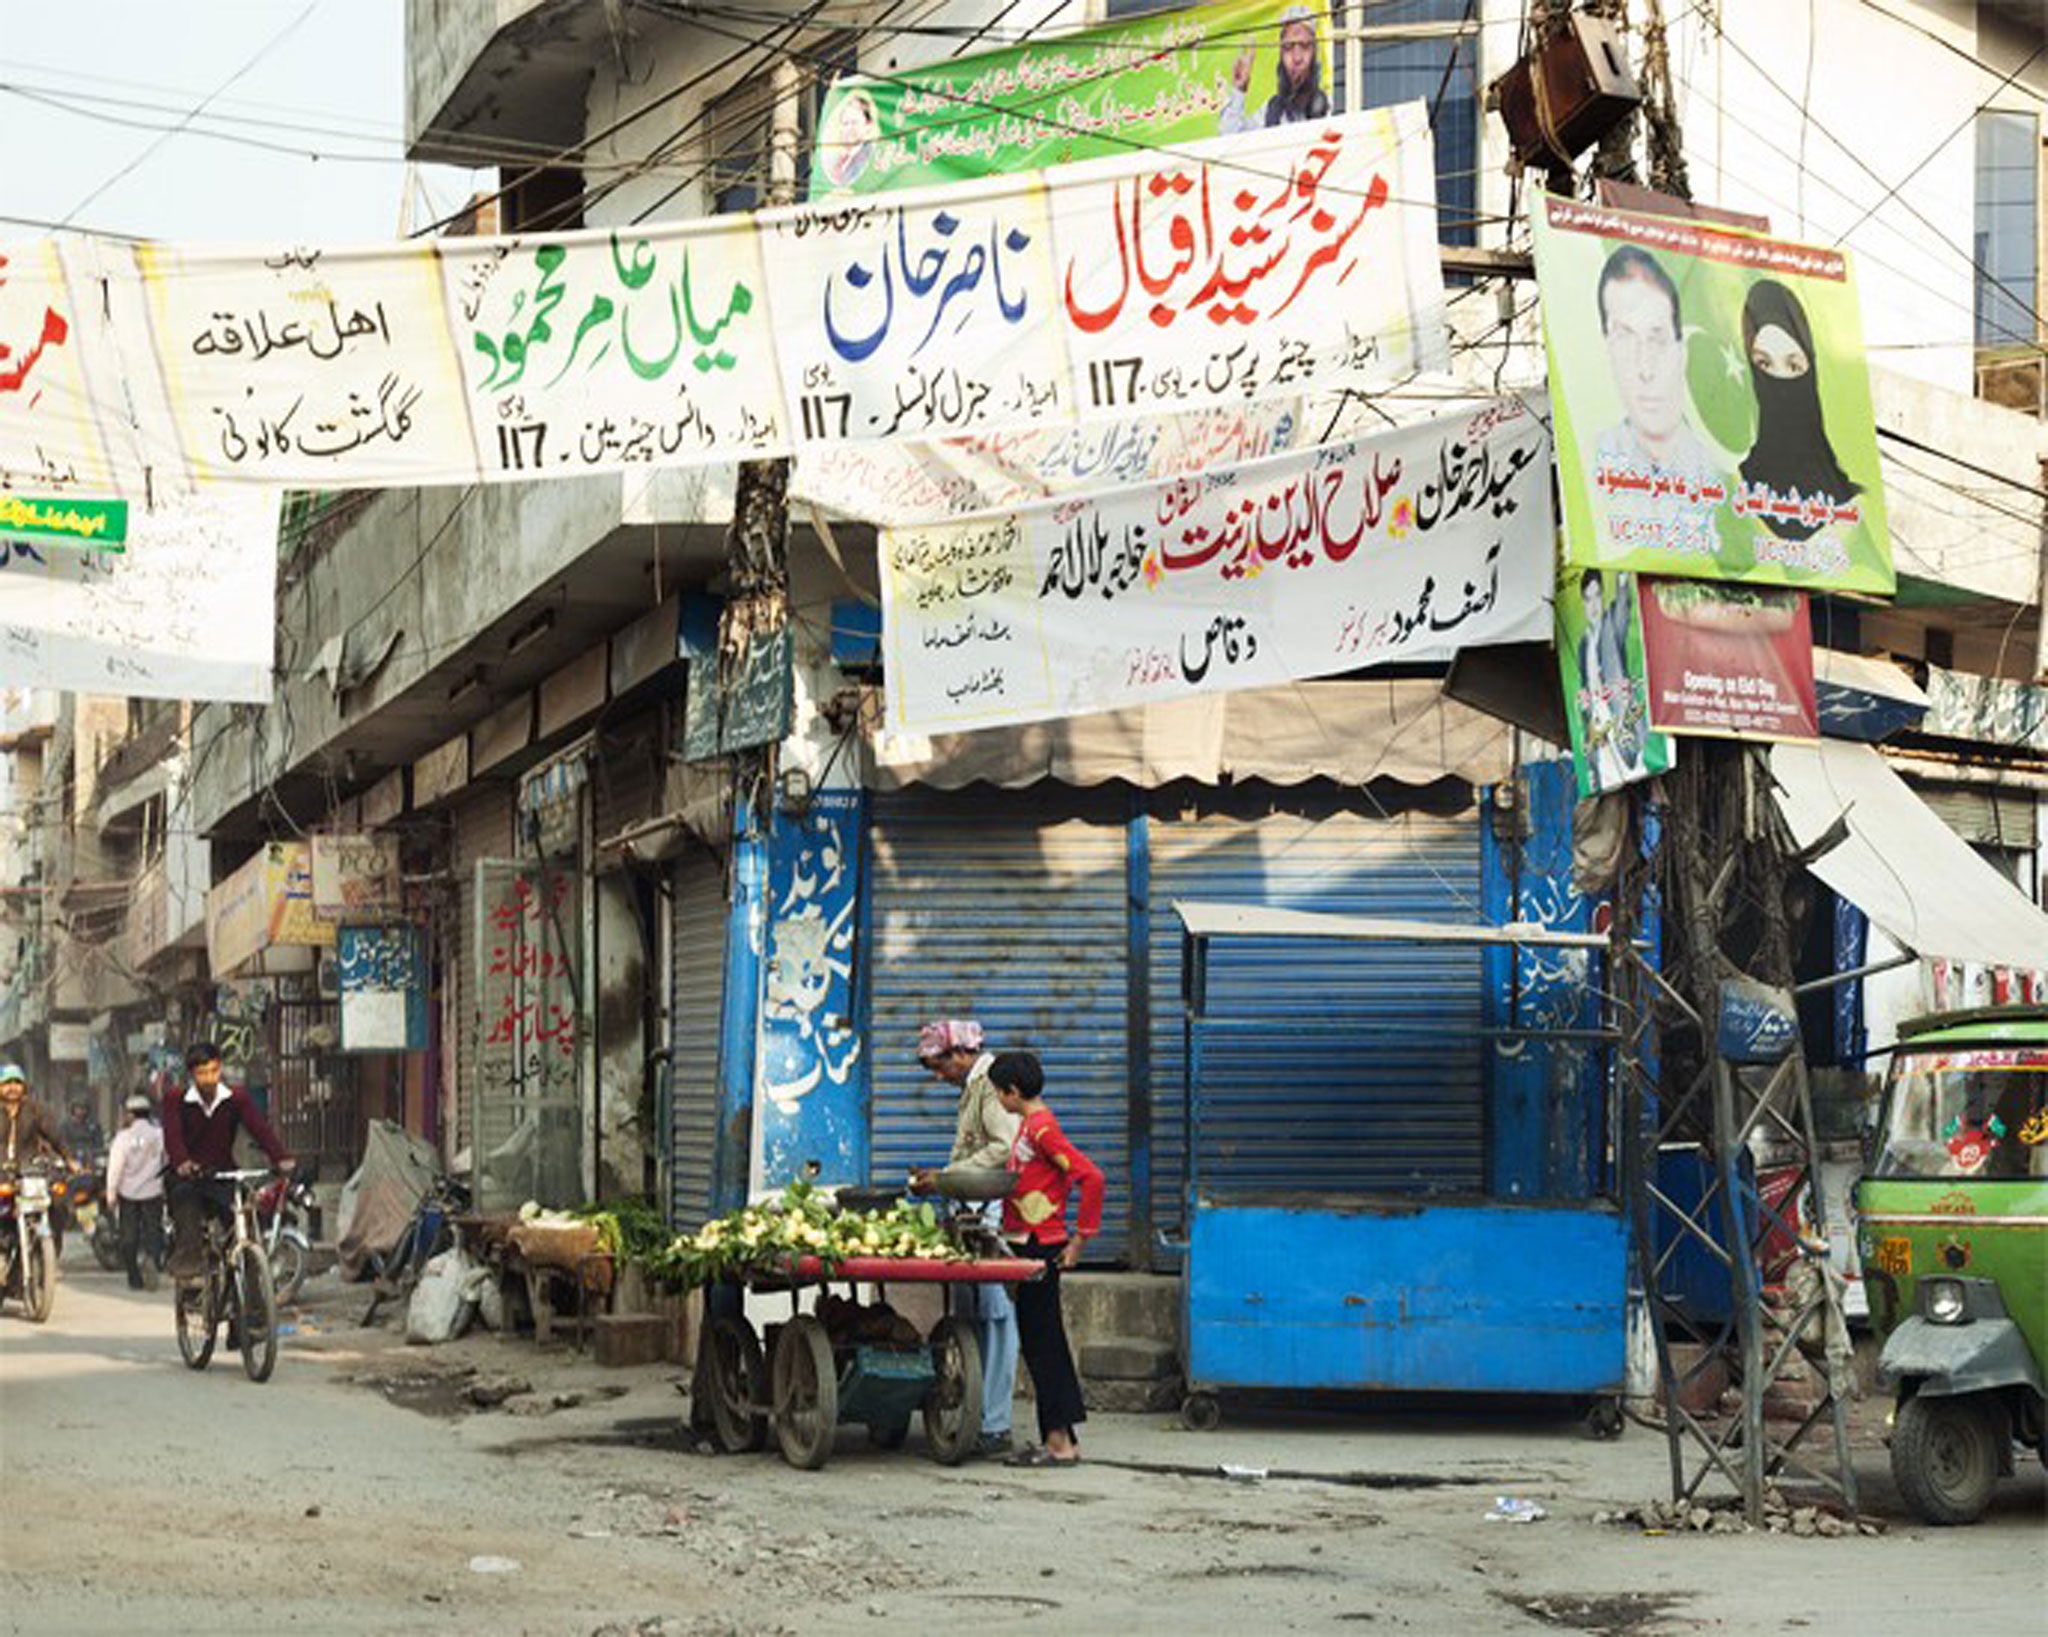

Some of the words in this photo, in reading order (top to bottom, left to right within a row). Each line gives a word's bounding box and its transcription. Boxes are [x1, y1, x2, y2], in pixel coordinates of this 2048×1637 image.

[824, 204, 962, 362] خان
[1064, 160, 1214, 333] اقبال
[496, 421, 548, 470] 117
[800, 393, 852, 440] 117
